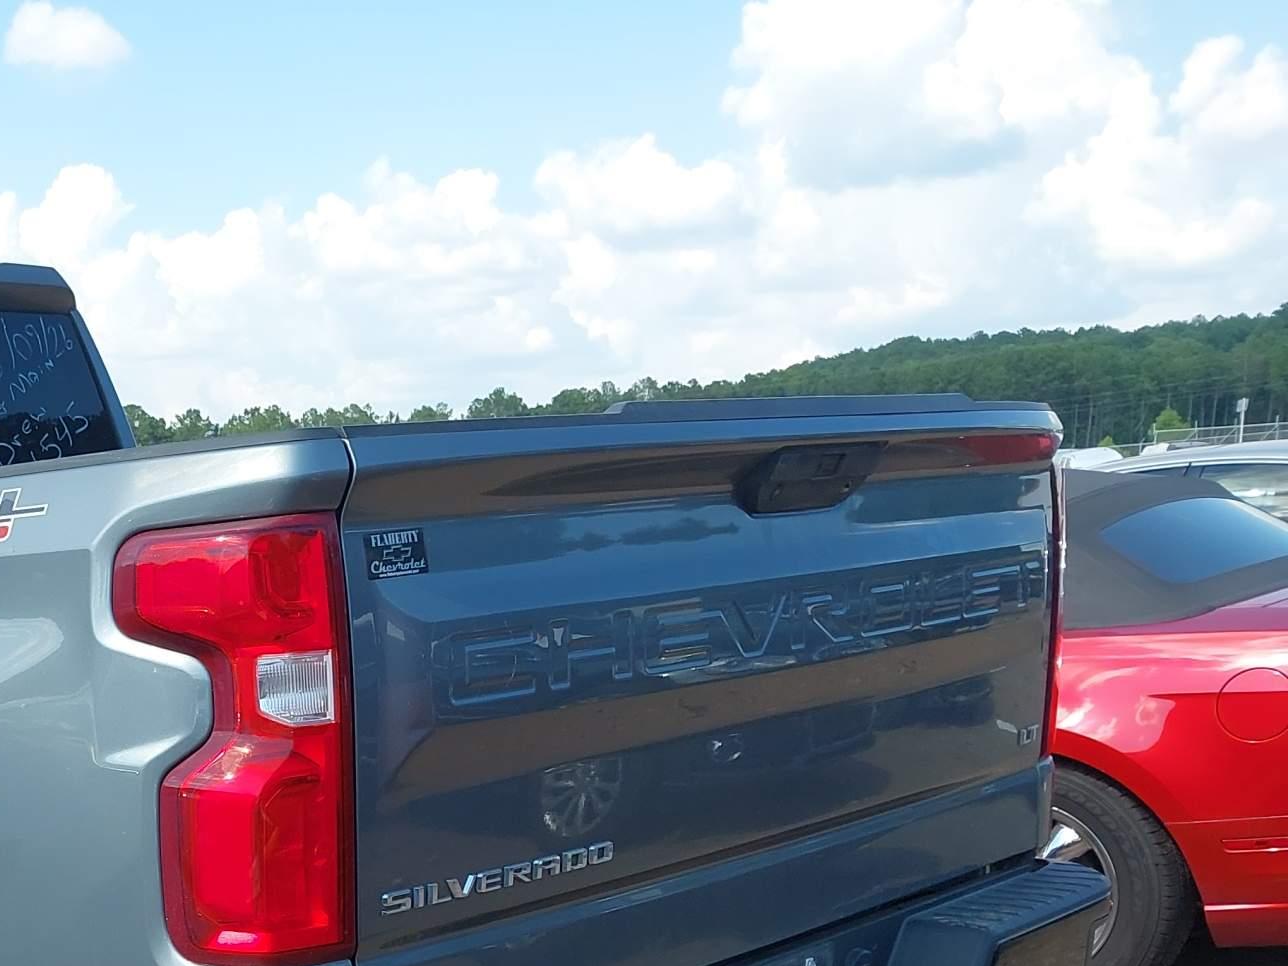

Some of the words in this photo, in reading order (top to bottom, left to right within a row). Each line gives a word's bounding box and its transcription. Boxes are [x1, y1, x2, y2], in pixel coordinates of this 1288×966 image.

[370, 557, 427, 574] Chevrolet
[446, 558, 1042, 707] CHEVROLET
[1017, 723, 1040, 746] LT
[380, 840, 615, 917] SILVERADO
